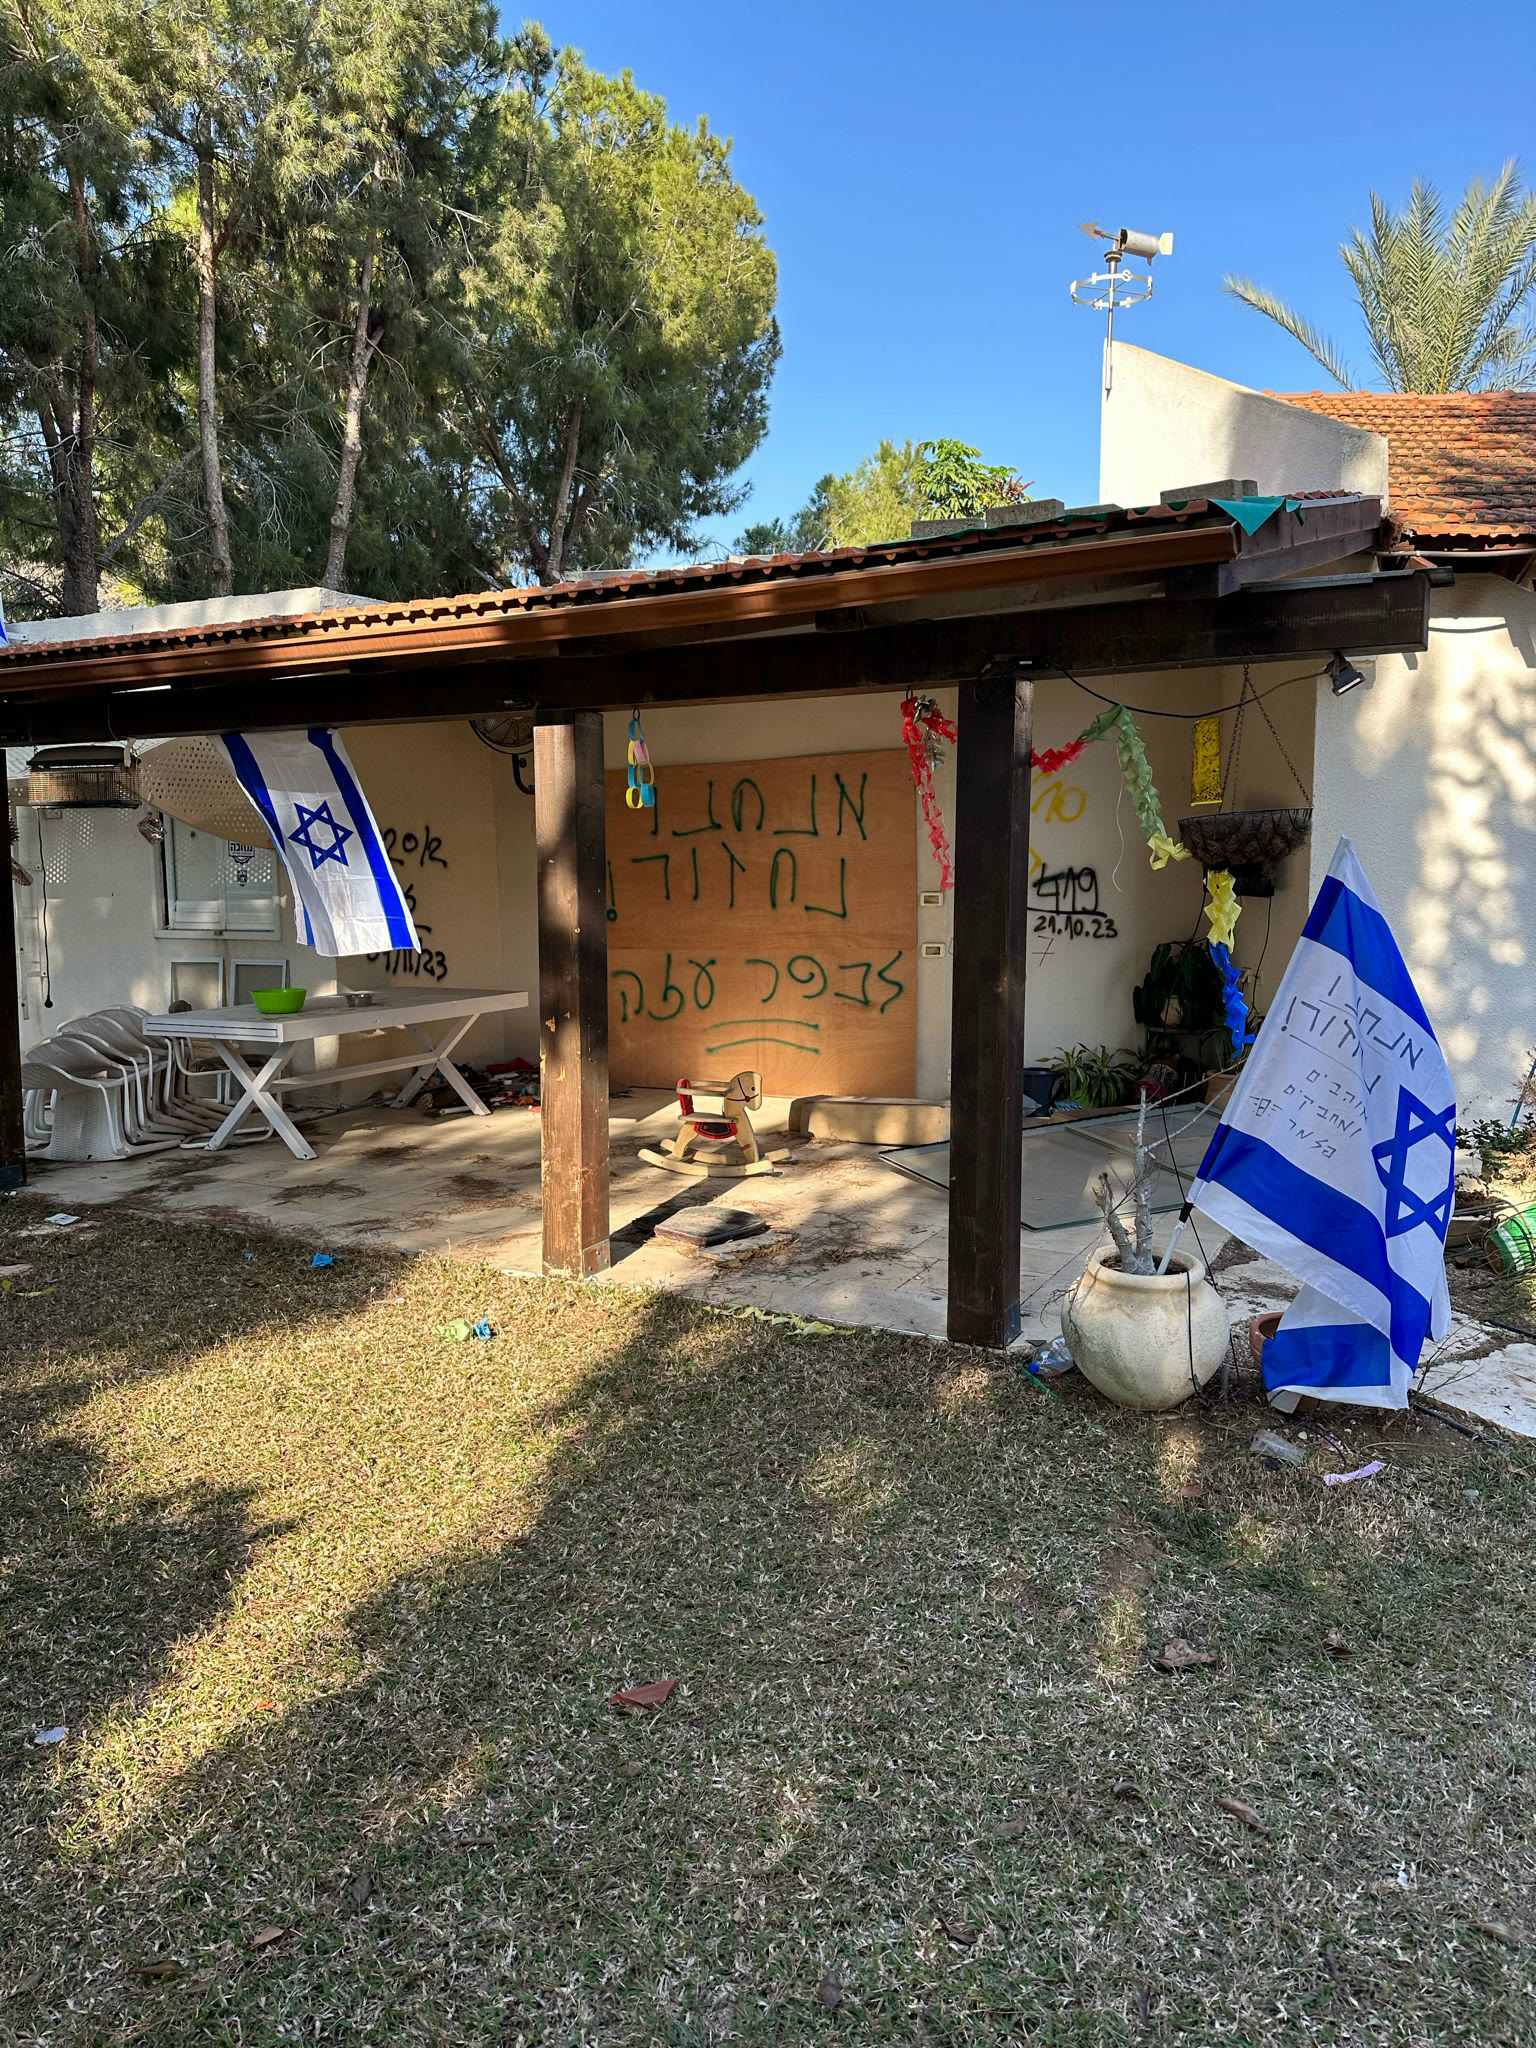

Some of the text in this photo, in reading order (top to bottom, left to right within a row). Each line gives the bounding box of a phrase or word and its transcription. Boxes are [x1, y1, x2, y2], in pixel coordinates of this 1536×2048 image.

[650, 772, 869, 841] אנחנו
[606, 841, 848, 922] נחזור!
[1033, 914, 1118, 940] 21.10.23
[610, 950, 904, 1023] לכפר עזה
